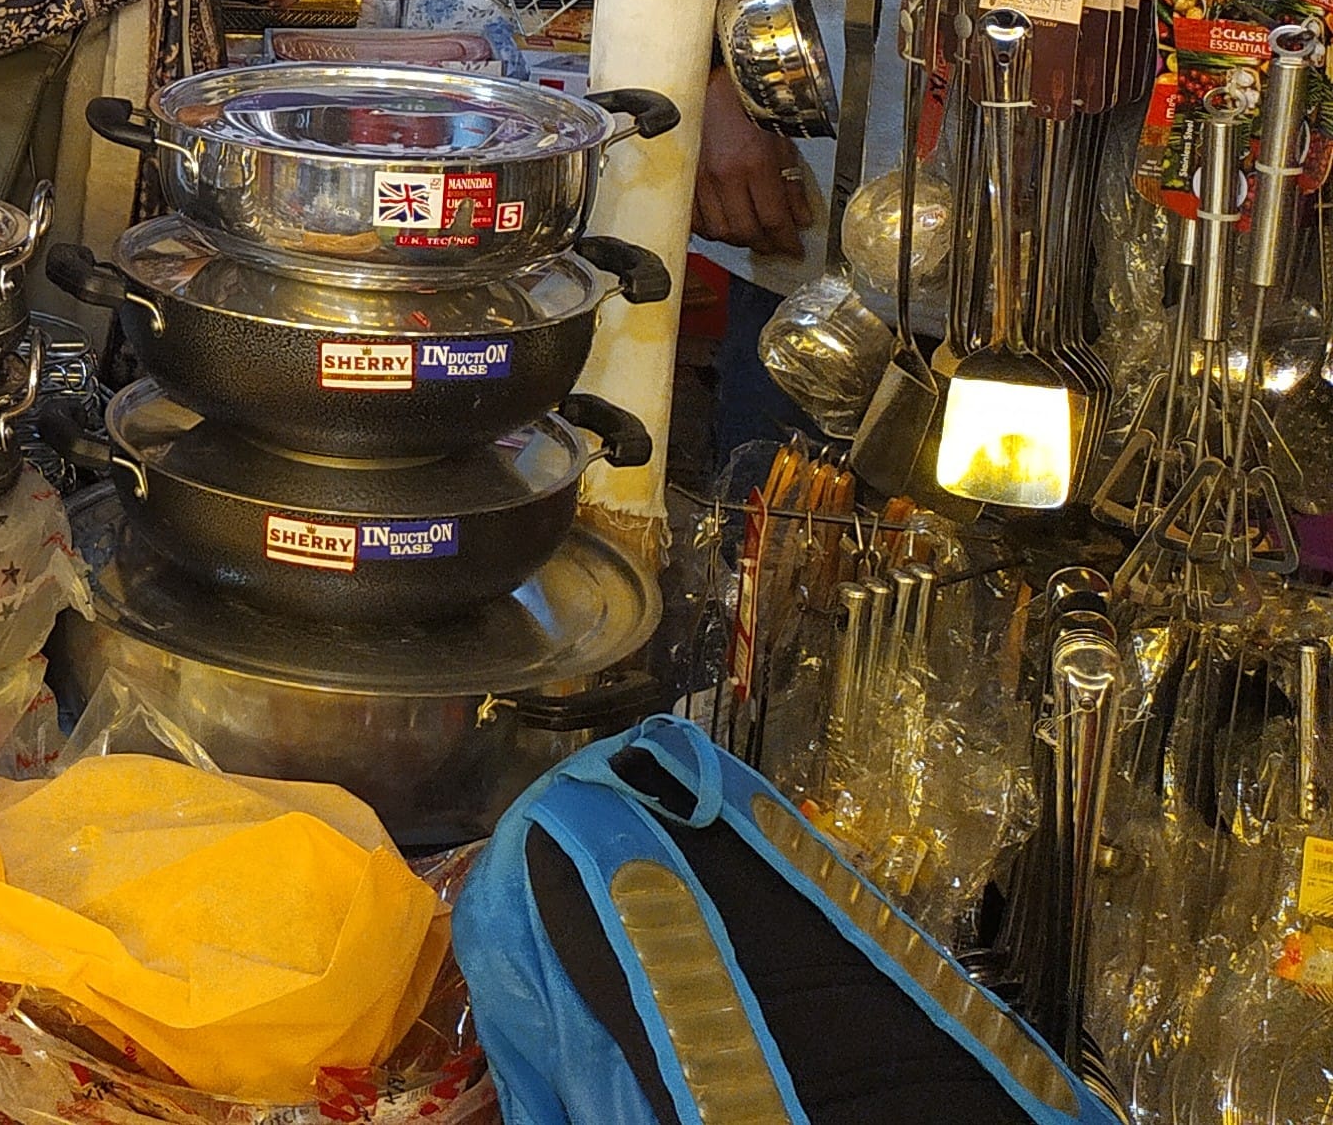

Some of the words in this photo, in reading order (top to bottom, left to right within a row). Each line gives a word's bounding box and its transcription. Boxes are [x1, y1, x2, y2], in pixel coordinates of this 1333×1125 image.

[1209, 39, 1270, 54] ESSENTIAL
[1223, 29, 1268, 43] CLASSI
[1183, 120, 1194, 142] Steel
[1179, 143, 1191, 178] Stainless
[448, 177, 493, 190] MANINDRA
[502, 207, 519, 228] 5
[323, 353, 410, 374] SHERRY
[421, 343, 507, 367] INDUCTION
[446, 362, 489, 376] BASE
[269, 529, 353, 555] SHERRY
[362, 523, 453, 546] INDUCTION
[390, 539, 433, 555] BASE
